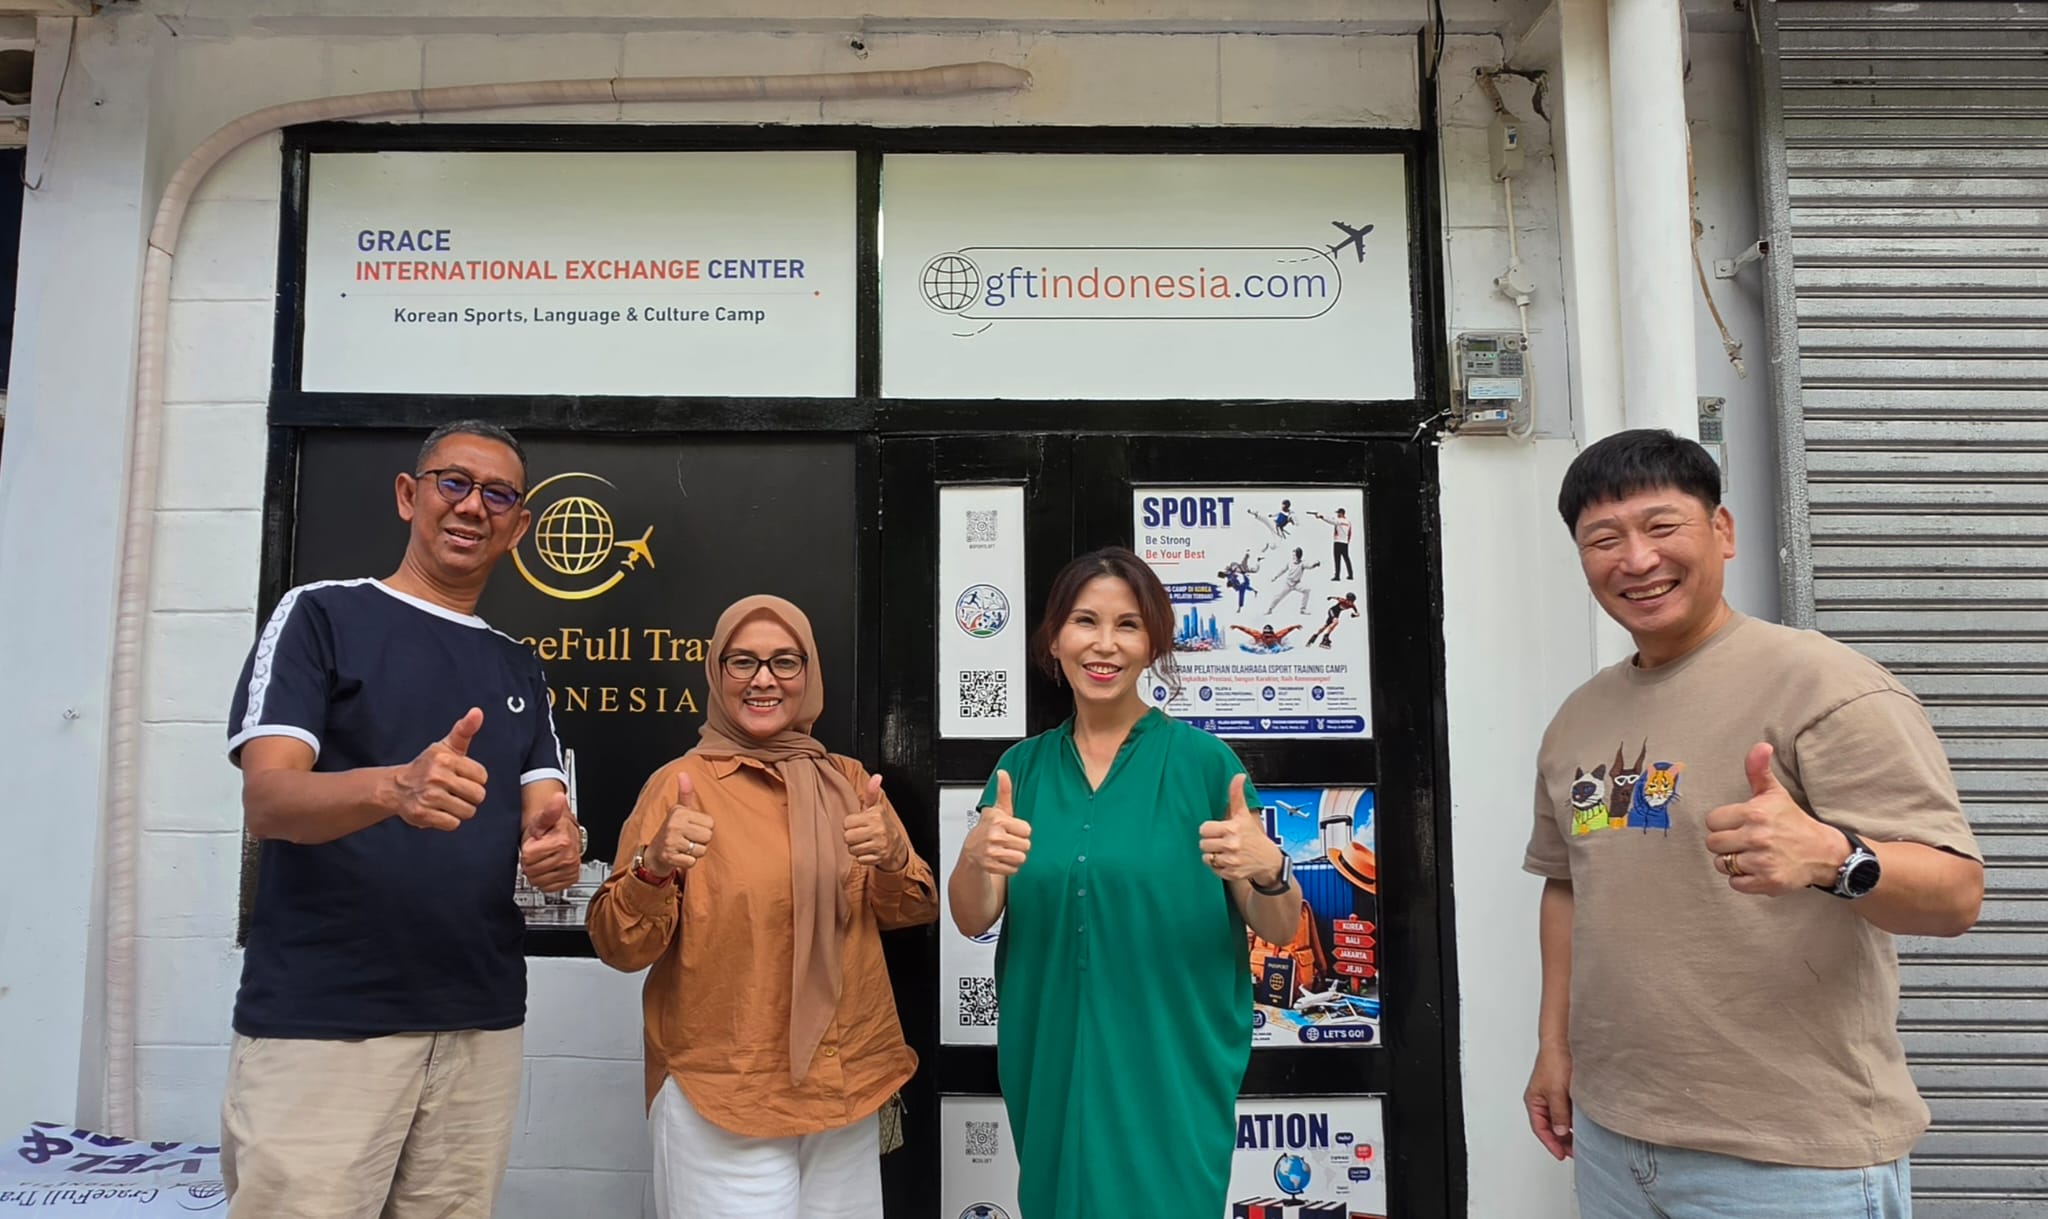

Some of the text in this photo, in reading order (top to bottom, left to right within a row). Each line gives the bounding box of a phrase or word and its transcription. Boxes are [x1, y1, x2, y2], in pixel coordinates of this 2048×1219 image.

[358, 229, 451, 252] GRACE
[356, 259, 805, 281] INTERNATIONAL EXCHANGE CENTER
[984, 266, 1327, 307] gftindonesia.com
[394, 307, 765, 326] Korean Sports, Language & Culture Camp
[1142, 496, 1234, 528] SPORT
[1145, 535, 1191, 547] Be Strong
[1145, 549, 1206, 559] Be Your Best
[643, 628, 713, 662] Tra
[1194, 664, 1230, 674] PELATIHAN
[1231, 664, 1267, 674] OLAHRAGA
[1294, 664, 1324, 674] TRAINING
[1342, 922, 1364, 931] KOREA
[1345, 936, 1360, 945] BALI
[1323, 1028, 1365, 1039] LET'S GO!
[1236, 1112, 1329, 1149] ATION
